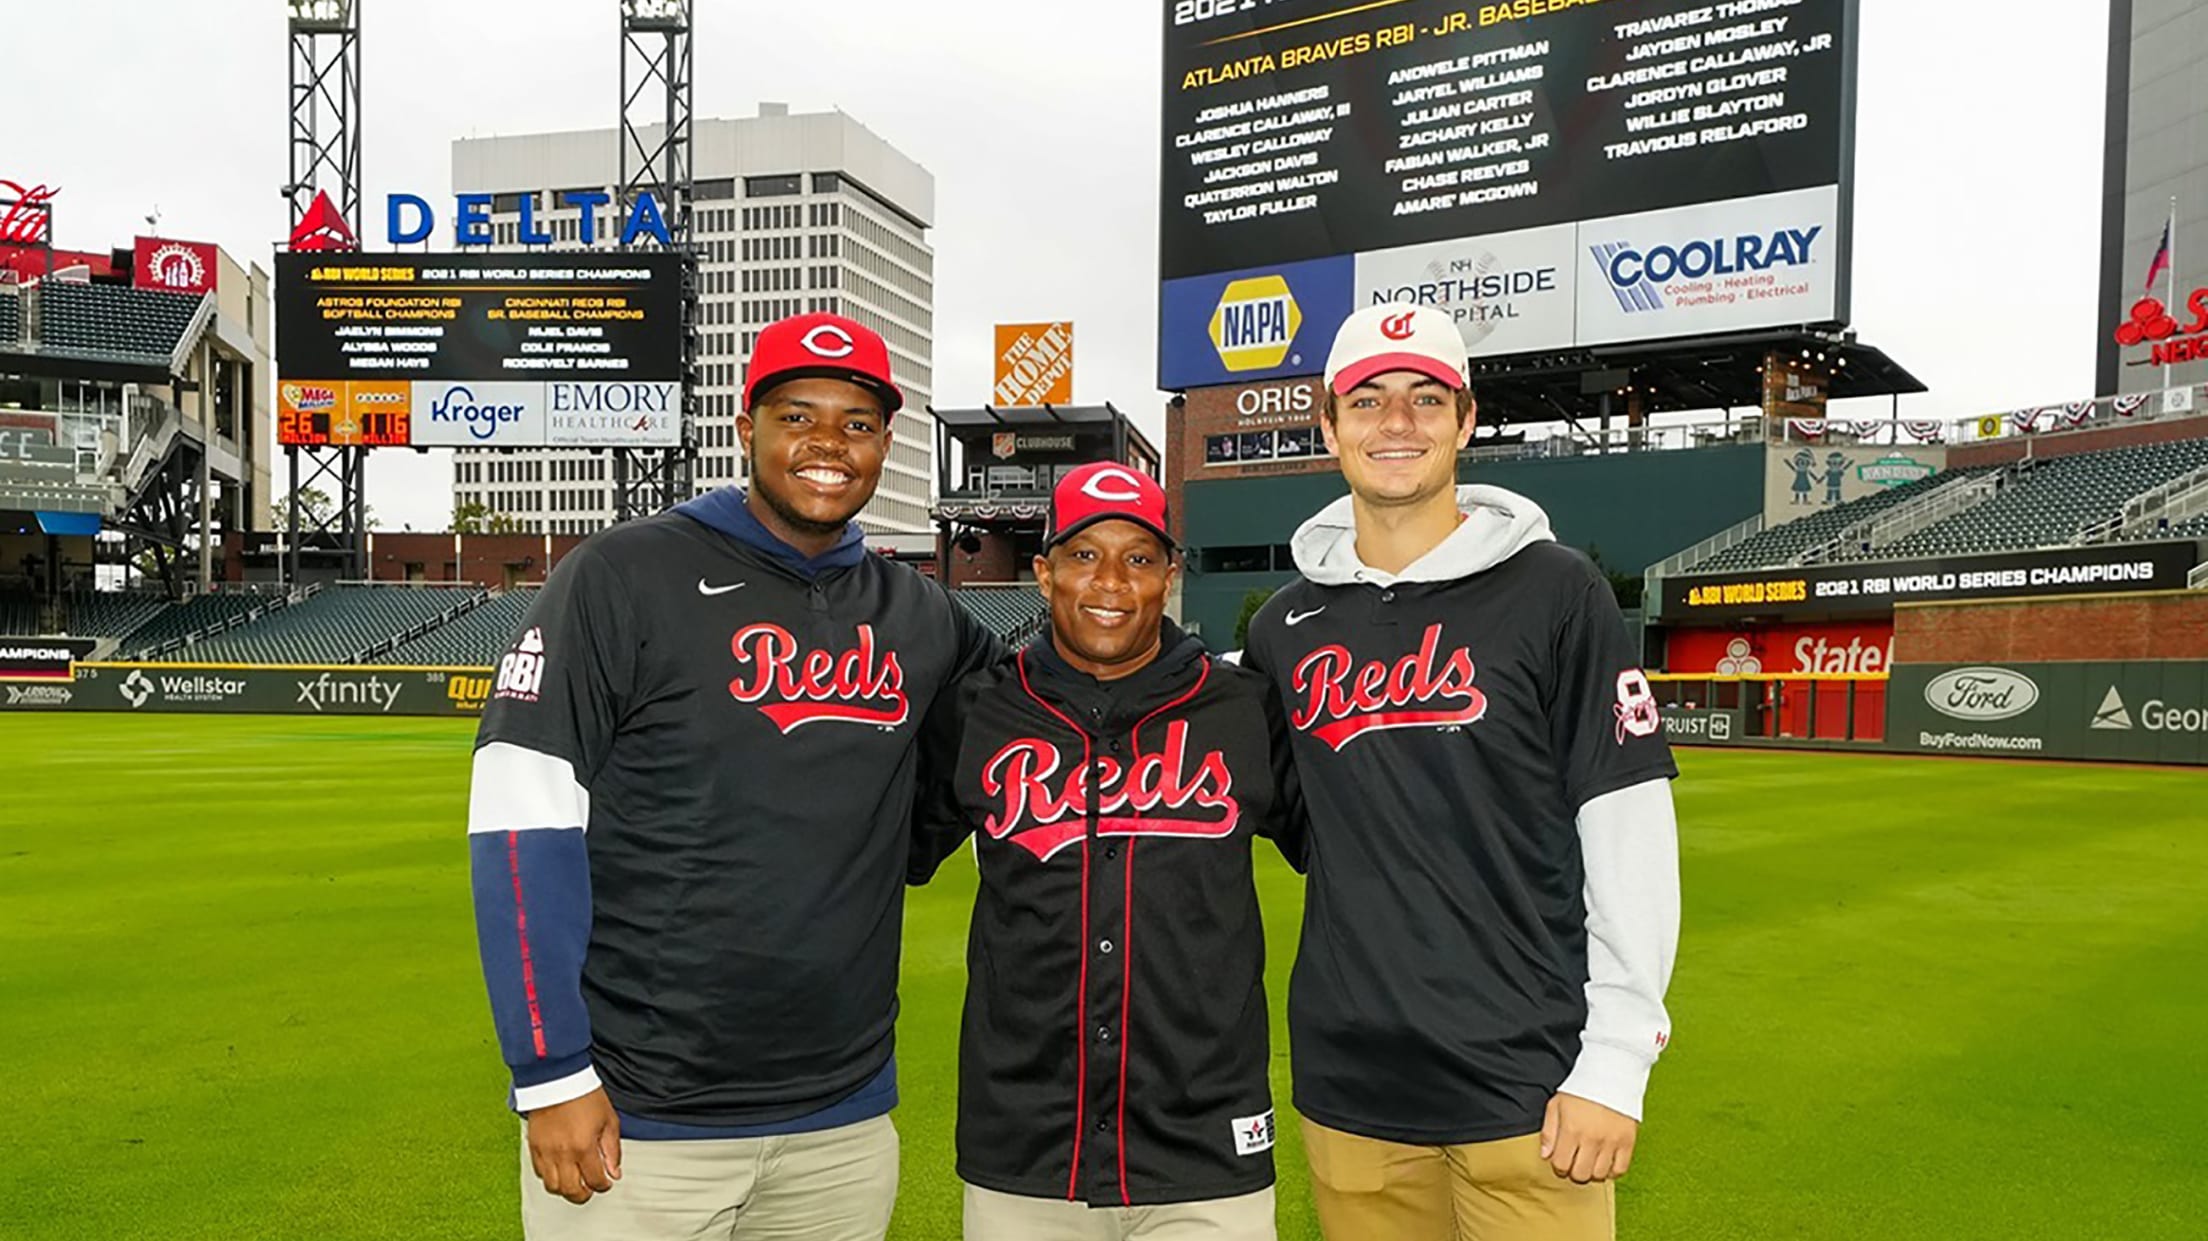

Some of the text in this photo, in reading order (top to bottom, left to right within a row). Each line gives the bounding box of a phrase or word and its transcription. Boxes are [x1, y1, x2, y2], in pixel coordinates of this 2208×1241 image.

[1614, 7, 1713, 39] TRAVAREZ
[1626, 16, 1789, 61] JAYDEN MOSLEY
[1182, 55, 1275, 89] ATLANTA
[1281, 33, 1370, 69] BRAVES
[1376, 24, 1415, 48] RBI
[1433, 12, 1472, 36] JR.
[1479, 0, 1601, 26] BASEB
[1388, 40, 1549, 85] ANDWELE PITTMAN
[1586, 33, 1832, 92] CLARENCE CALLAWAY, JR
[1392, 65, 1543, 106] JARYEL WILLIAMS
[1624, 67, 1788, 109] JORDYN GLOVER
[1196, 85, 1329, 124] JOSHUA HANNERS
[1401, 90, 1533, 127] JULIAN CARTER
[1626, 107, 1691, 132] WILLIE
[1176, 121, 1251, 147] CLARENCE
[1253, 105, 1335, 133] CALLAWAY,
[1399, 112, 1535, 149] ZACHARY KELLY
[1604, 113, 1808, 160] TRAVIOUS RELAFORD
[1191, 128, 1333, 165] WESLEY CALLOWAY
[1385, 132, 1549, 173] FABIAN WALKER, JR
[1203, 151, 1318, 184] JACKSON DAVIS
[1402, 159, 1530, 192] CHASE REEVES
[1184, 169, 1338, 208] QUATERRION WALTON
[1393, 194, 1457, 216] AMARE'
[387, 191, 673, 245] DELTA
[1203, 194, 1318, 225] TAYLOR FULLER
[343, 267, 380, 281] WORLD
[381, 267, 415, 281] SERIES
[422, 269, 457, 280] 2021
[459, 269, 480, 280] RBI
[482, 269, 527, 280] WORLD
[529, 269, 574, 280] SERIES
[576, 269, 652, 281] CHAMPIONS
[1610, 225, 1822, 287] COOLRAY
[316, 298, 462, 308] ASTROS FOUNDATION RBI
[505, 298, 569, 308] CINCINNATI
[606, 298, 627, 308] RBI
[1372, 267, 1556, 306] NORTHSIDE
[1664, 273, 1775, 297] Cooling Heating
[1675, 282, 1809, 307] Plumbing Electrical
[323, 309, 456, 319] SOFTBALL CHAMPIONS
[509, 309, 571, 319] BASEBALL
[573, 309, 644, 320] CHAMPIONS
[1224, 300, 1286, 347] NAPA
[1454, 302, 1520, 324] PITAL
[800, 324, 854, 358] C
[1001, 332, 1035, 365] THE
[502, 358, 575, 369] ROOSEVELT
[995, 321, 1073, 406] HOME
[1024, 352, 1072, 406] DEPOT
[432, 386, 525, 439] Kroger
[553, 384, 674, 412] EMORY
[1237, 384, 1313, 416] ORIS
[284, 412, 312, 434] 26
[553, 414, 669, 431] HEALTHCARE
[1016, 435, 1074, 449] CLUBHOUSE
[1081, 468, 1141, 501] C
[1723, 582, 1765, 604] WORLD
[1766, 579, 1806, 602] SERIES
[1815, 579, 1859, 598] 2021
[1863, 577, 1891, 595] RBI
[1893, 574, 1957, 593] WORLD
[1959, 569, 2028, 589] SERIES
[2030, 562, 2154, 586] CHAMPIONS
[0, 648, 70, 660] AMPIONS
[1792, 636, 1882, 673] State
[160, 676, 247, 695] Wellstar
[496, 652, 545, 695] RBI
[729, 622, 909, 734] Reds
[1291, 623, 1488, 752] Reds
[297, 673, 402, 711] xfinity
[1947, 674, 2015, 710] Ford
[2141, 699, 2208, 732] Geor
[1919, 731, 2042, 750] BuyFordNow.com
[981, 720, 1240, 862] Reds
